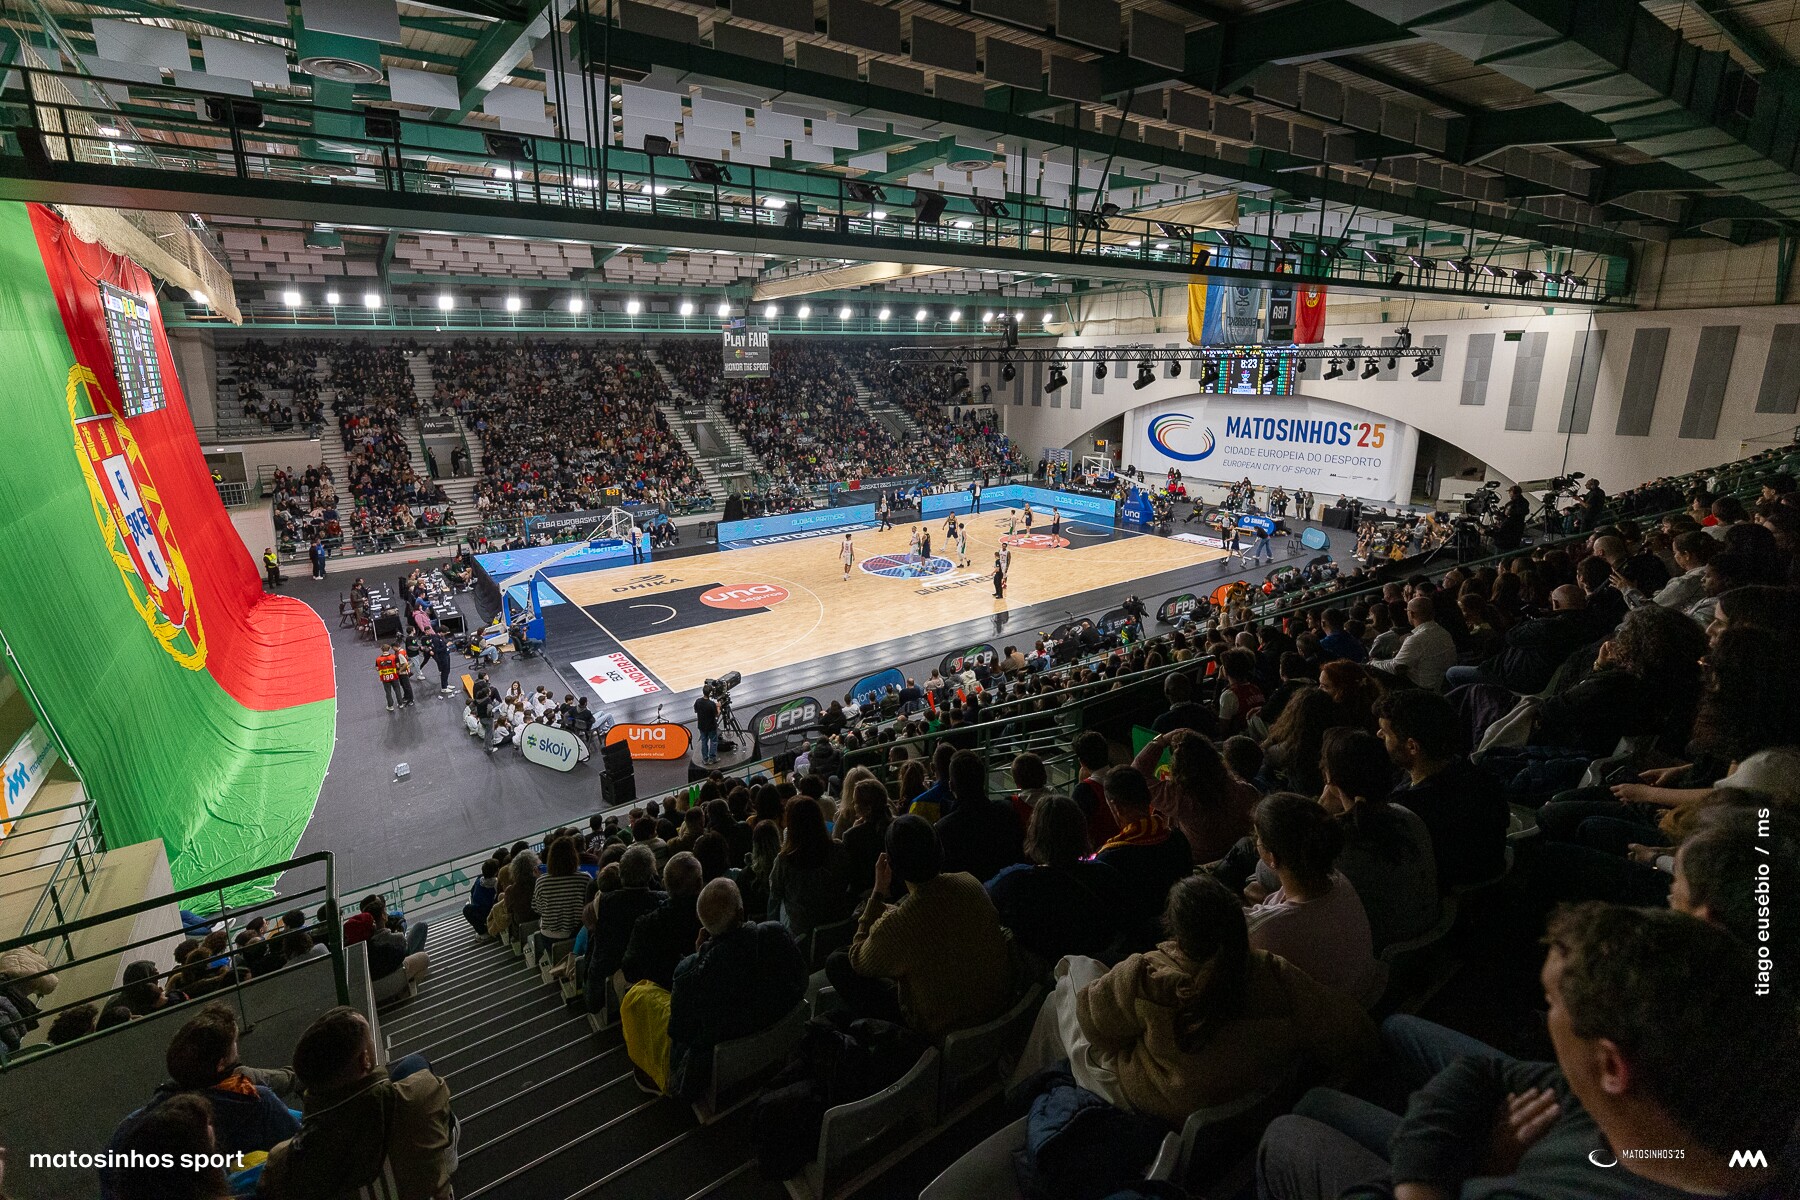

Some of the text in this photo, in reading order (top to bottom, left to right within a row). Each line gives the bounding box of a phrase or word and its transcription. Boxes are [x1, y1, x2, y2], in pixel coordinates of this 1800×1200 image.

[724, 332, 768, 347] PLAY FAIR
[753, 362, 769, 371] SPORT
[1240, 359, 1257, 368] 8:23
[1224, 446, 1382, 468] CIDADE EUROPEIA DO DESPORTO
[1222, 459, 1322, 476] EUROPEAN CITY OF SPORT
[1055, 496, 1100, 509] GLOBAL PARTNERS
[792, 513, 845, 526] GLOBAL PARTNERS
[1125, 510, 1140, 518] una
[537, 521, 556, 529] FIBA
[557, 515, 601, 526] EUROBASKET
[612, 578, 684, 593] DHIKA
[704, 585, 776, 601] una
[740, 592, 784, 602] seguros
[1176, 599, 1196, 613] FPB
[608, 653, 659, 693] BANDEIRAS
[776, 704, 816, 729] FPB
[628, 728, 666, 740] una
[539, 738, 571, 762] skoiy
